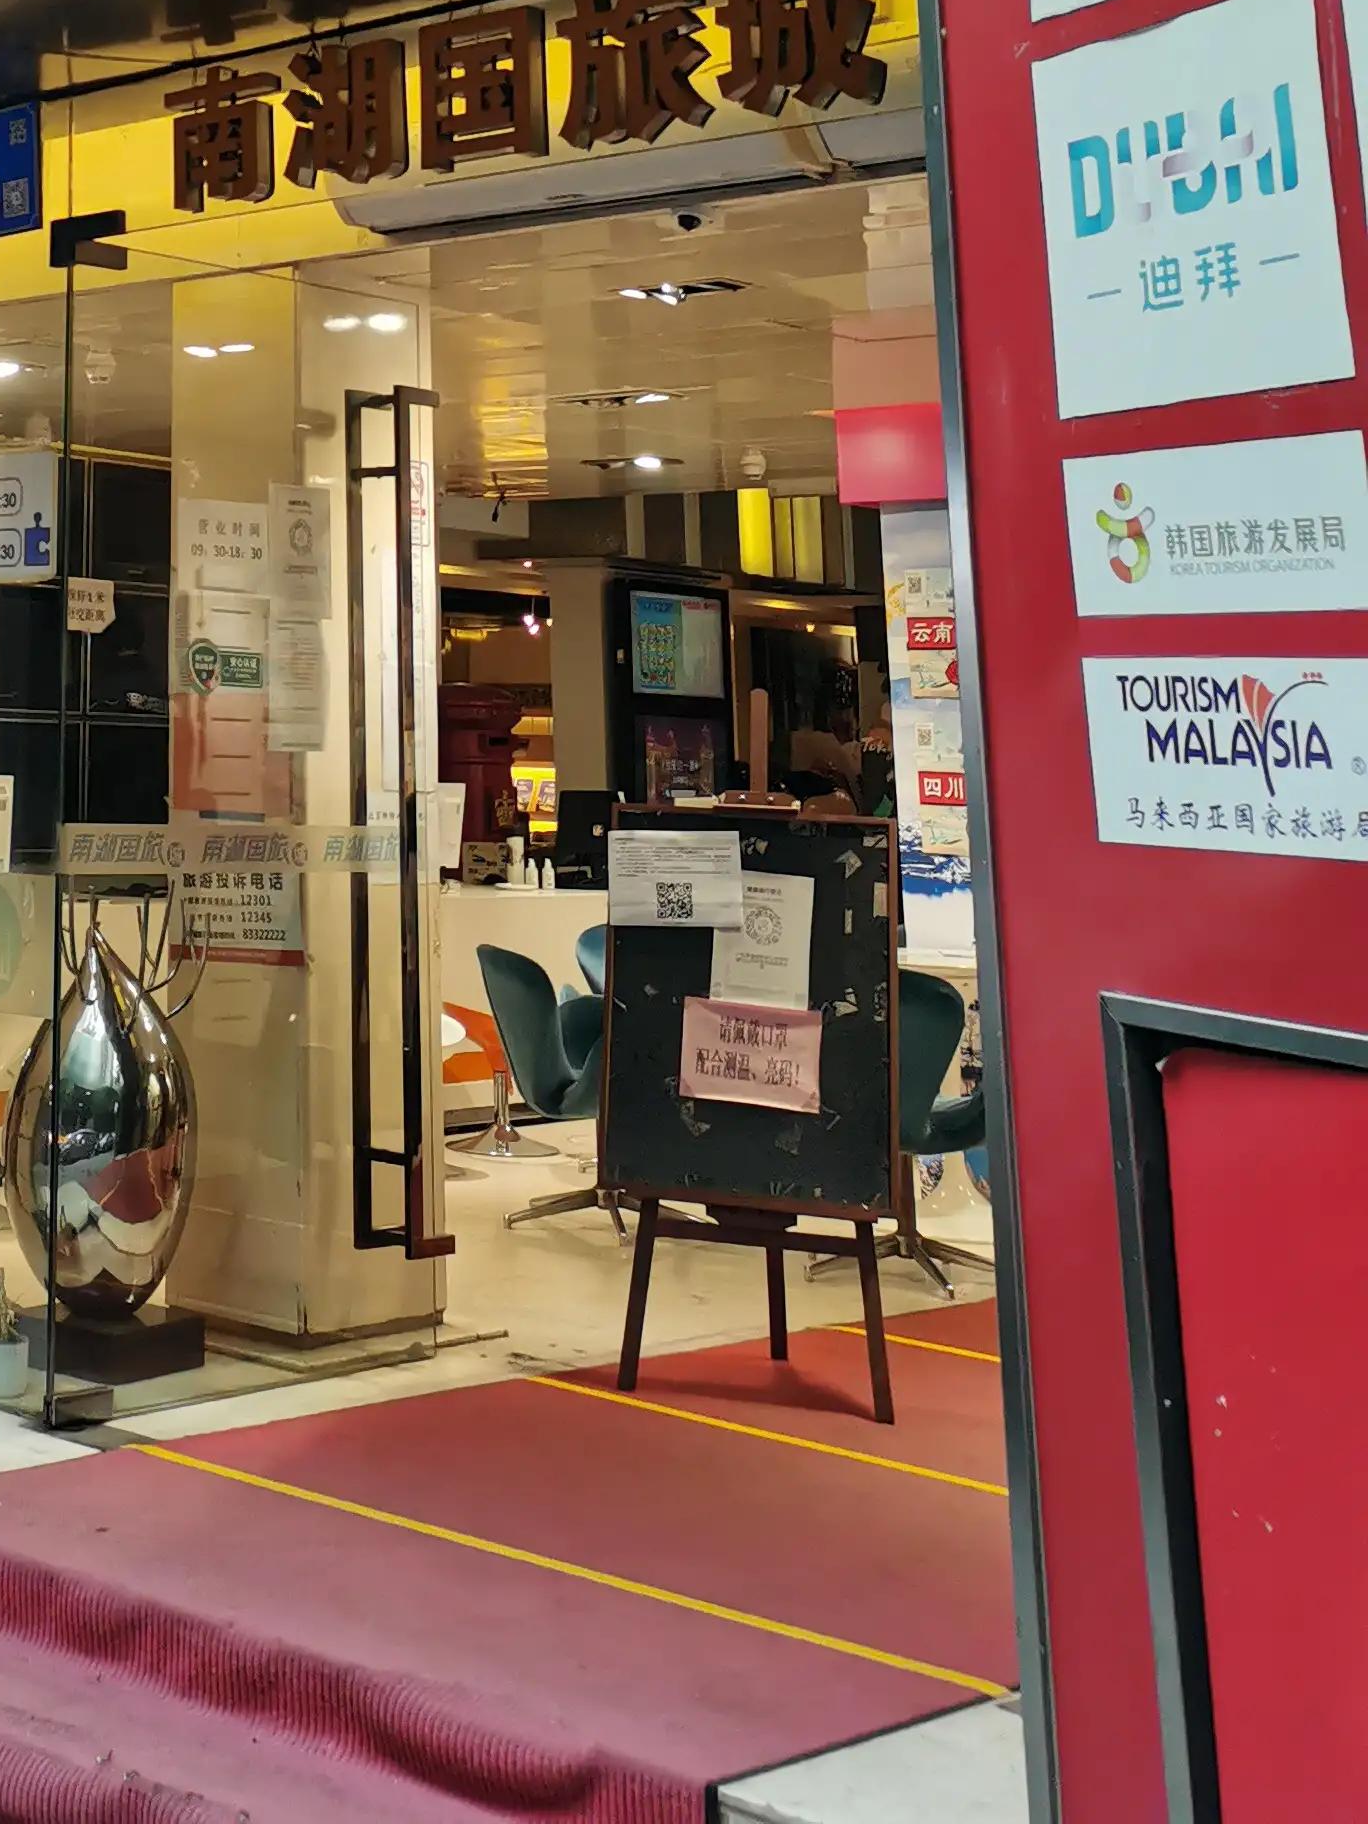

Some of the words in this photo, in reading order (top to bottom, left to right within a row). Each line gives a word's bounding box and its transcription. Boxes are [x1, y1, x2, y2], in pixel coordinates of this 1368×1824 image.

[1139, 241, 1242, 313] 迪拜
[198, 519, 261, 538] 营业时间
[1164, 515, 1346, 560] 韩国旅游发展局
[1206, 560, 1250, 576] TOURISM
[911, 622, 953, 645] 云南
[1117, 674, 1242, 714] TOURISM
[1145, 717, 1334, 794] MALAYSIA
[923, 776, 964, 801] 四川
[69, 831, 167, 863] 南湖国旅
[199, 833, 291, 865] 南湖国旅
[240, 894, 273, 906] 12301
[240, 911, 273, 924] 12345
[719, 1015, 789, 1051] 请佩戴口罩
